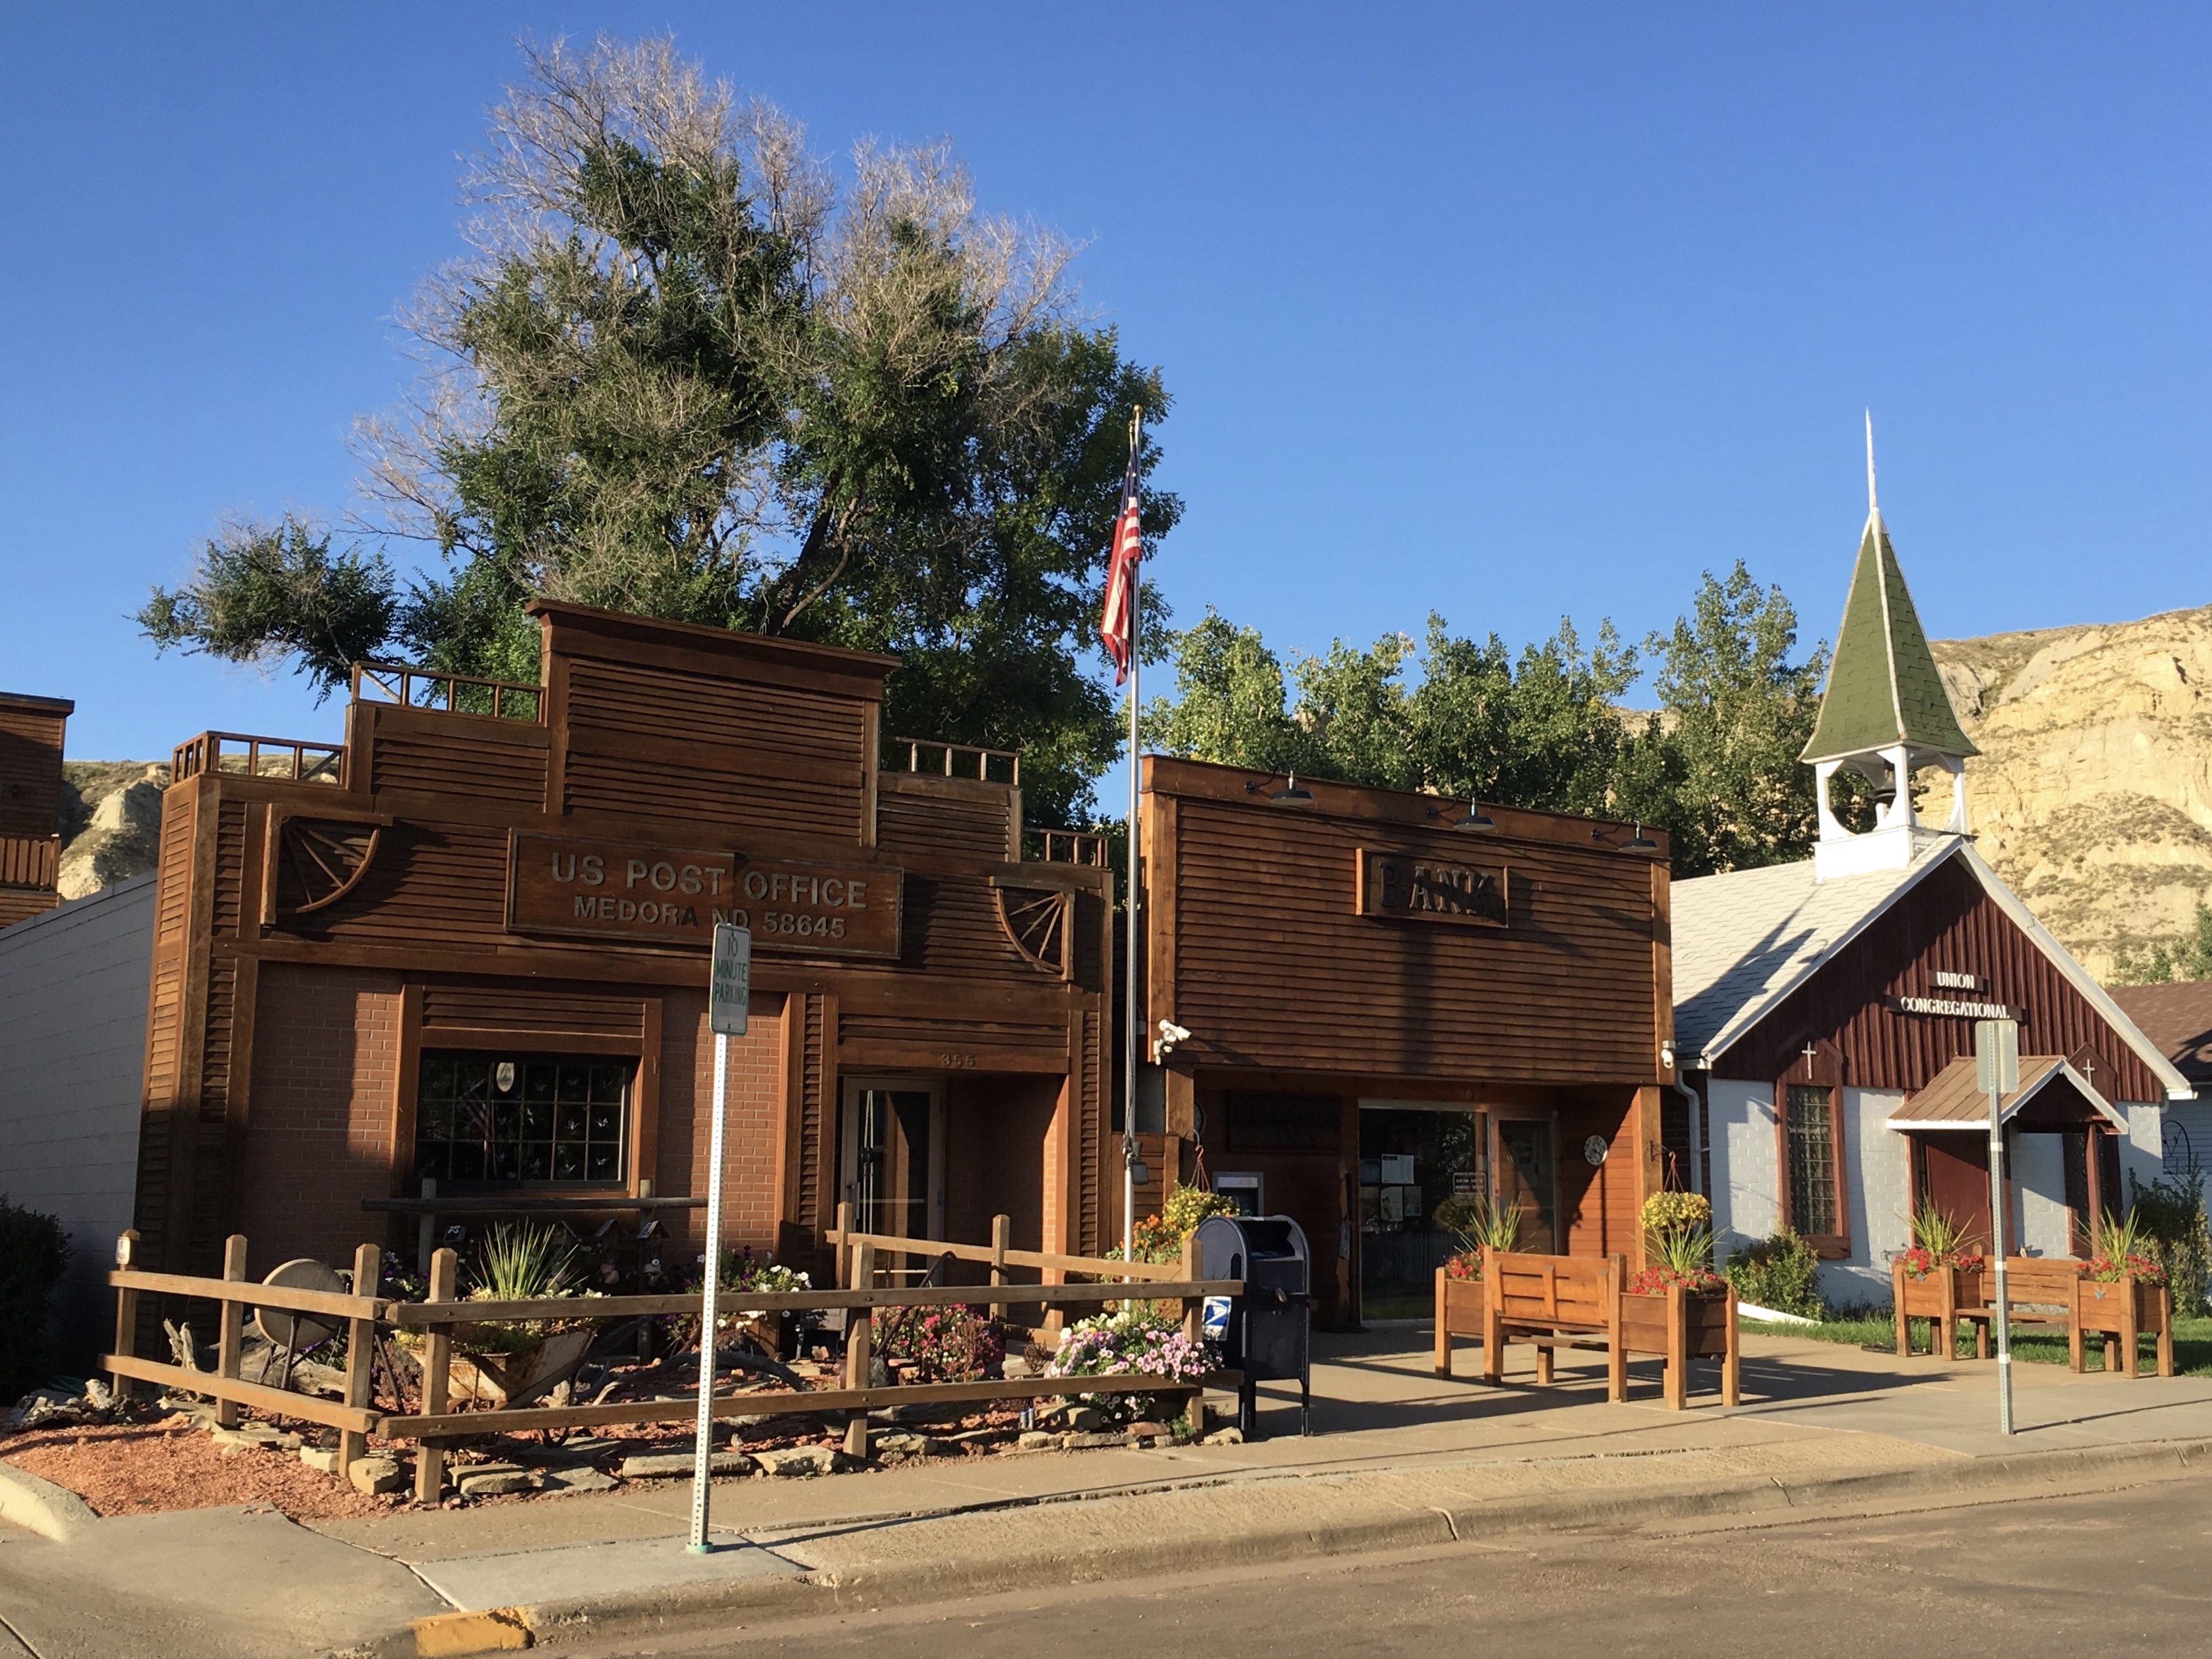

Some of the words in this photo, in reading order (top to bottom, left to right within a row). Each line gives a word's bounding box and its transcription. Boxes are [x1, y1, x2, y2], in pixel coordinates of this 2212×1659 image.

[551, 852, 605, 886] US
[627, 859, 726, 896] POST
[743, 871, 868, 909] OFFICE
[1378, 860, 1492, 916] BANK
[573, 896, 699, 928] MEDORA
[711, 907, 750, 929] ND
[762, 912, 847, 939] 58645
[727, 937, 738, 957] 10
[715, 958, 748, 982] MINUTE
[1936, 971, 1976, 989] UNION
[714, 982, 746, 1006] PARKING
[1900, 996, 2011, 1019] CONGREGATIONAL
